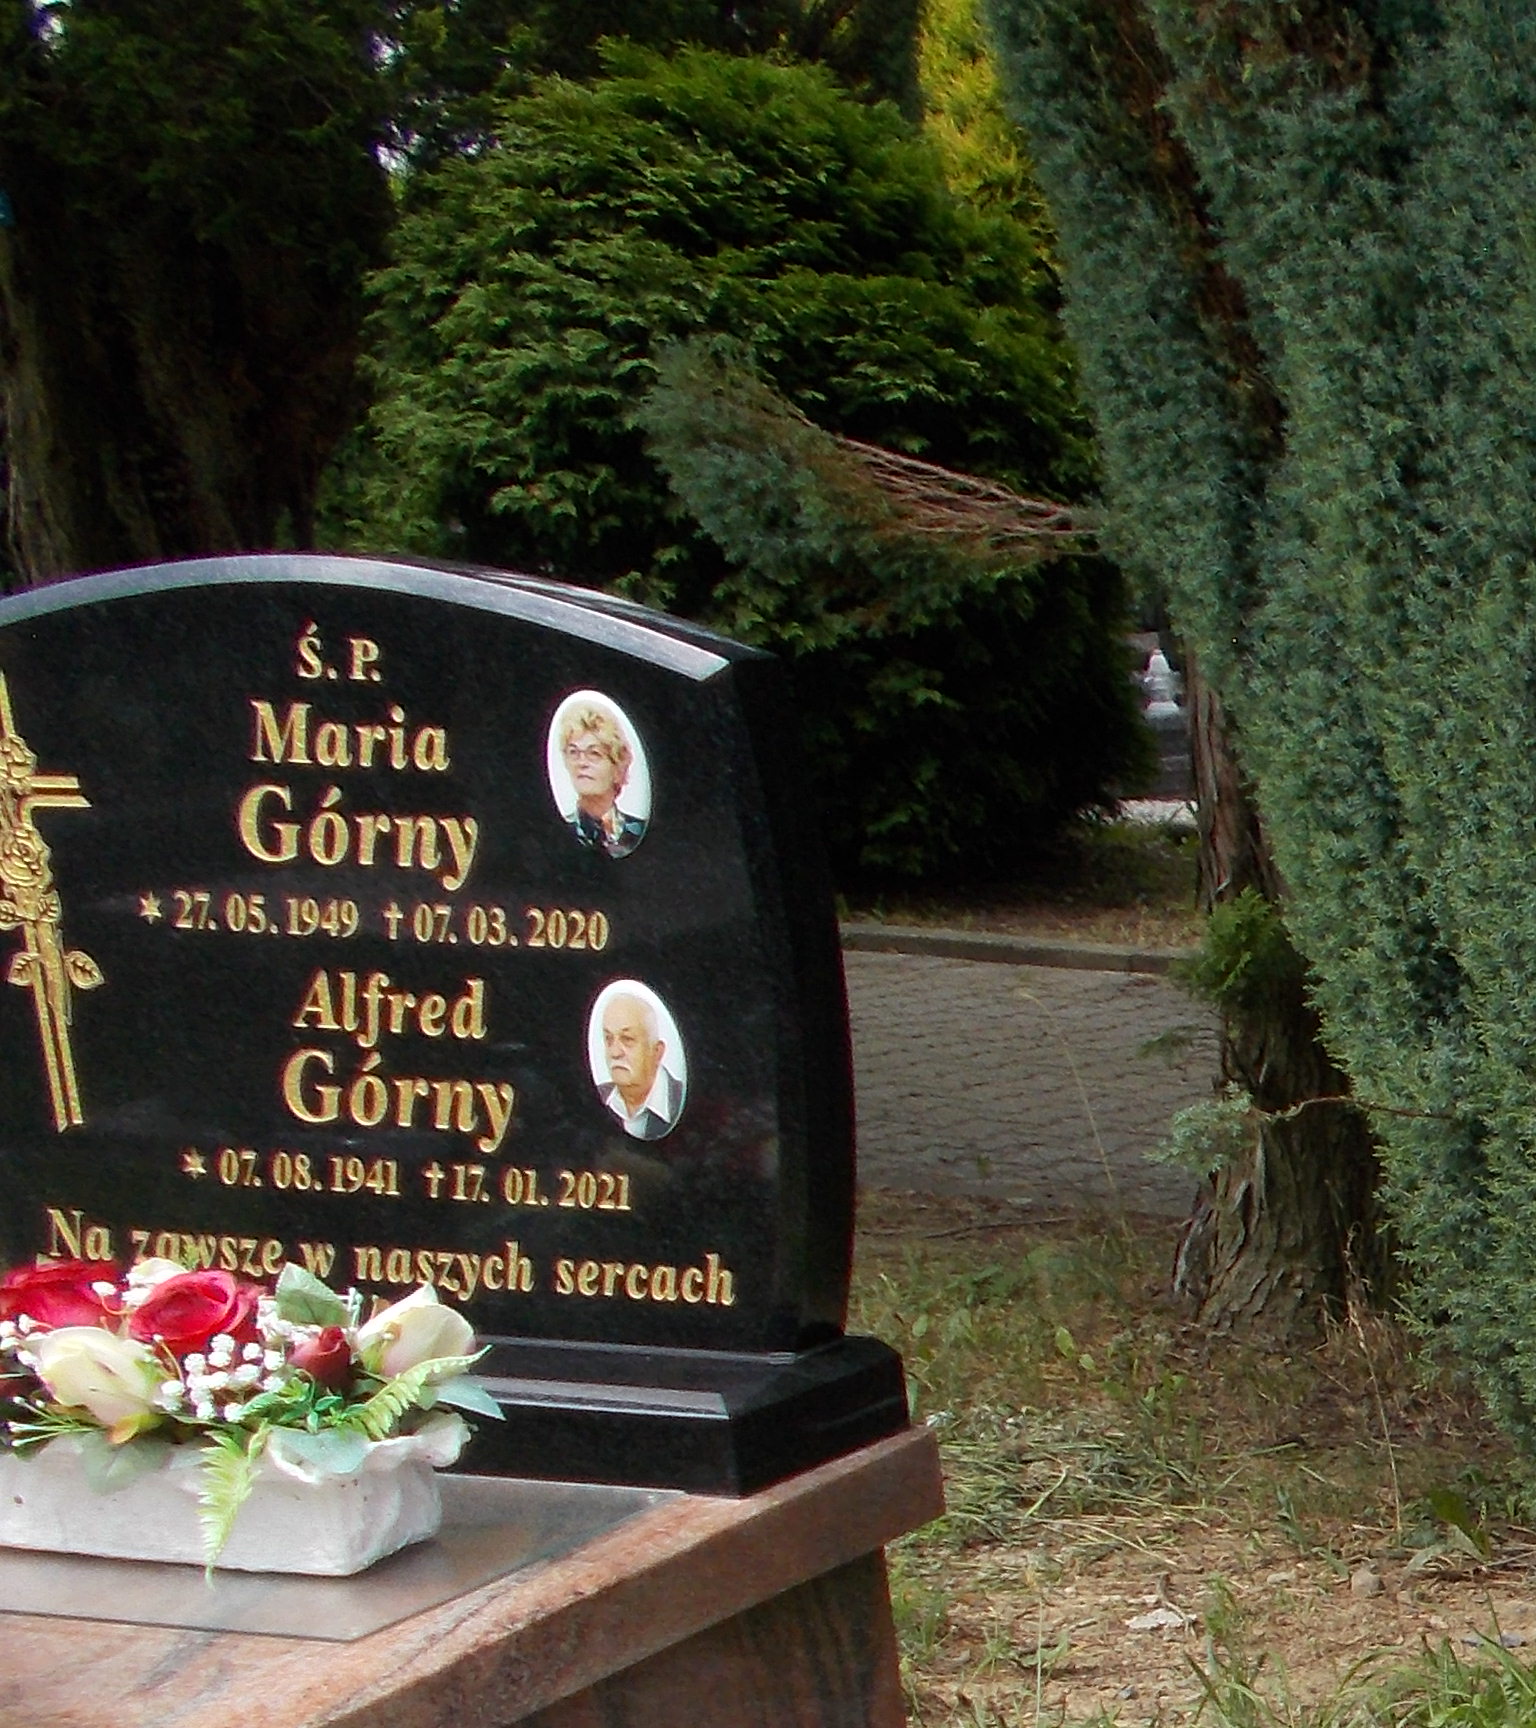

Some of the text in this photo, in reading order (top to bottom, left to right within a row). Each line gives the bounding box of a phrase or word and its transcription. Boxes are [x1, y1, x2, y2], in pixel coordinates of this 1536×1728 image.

[249, 699, 450, 772] Maria
[239, 784, 478, 891] Górny
[294, 970, 487, 1048] Alfred
[282, 1048, 515, 1154] Górny
[47, 1208, 736, 1306] Na zawsze w naszych sercach
